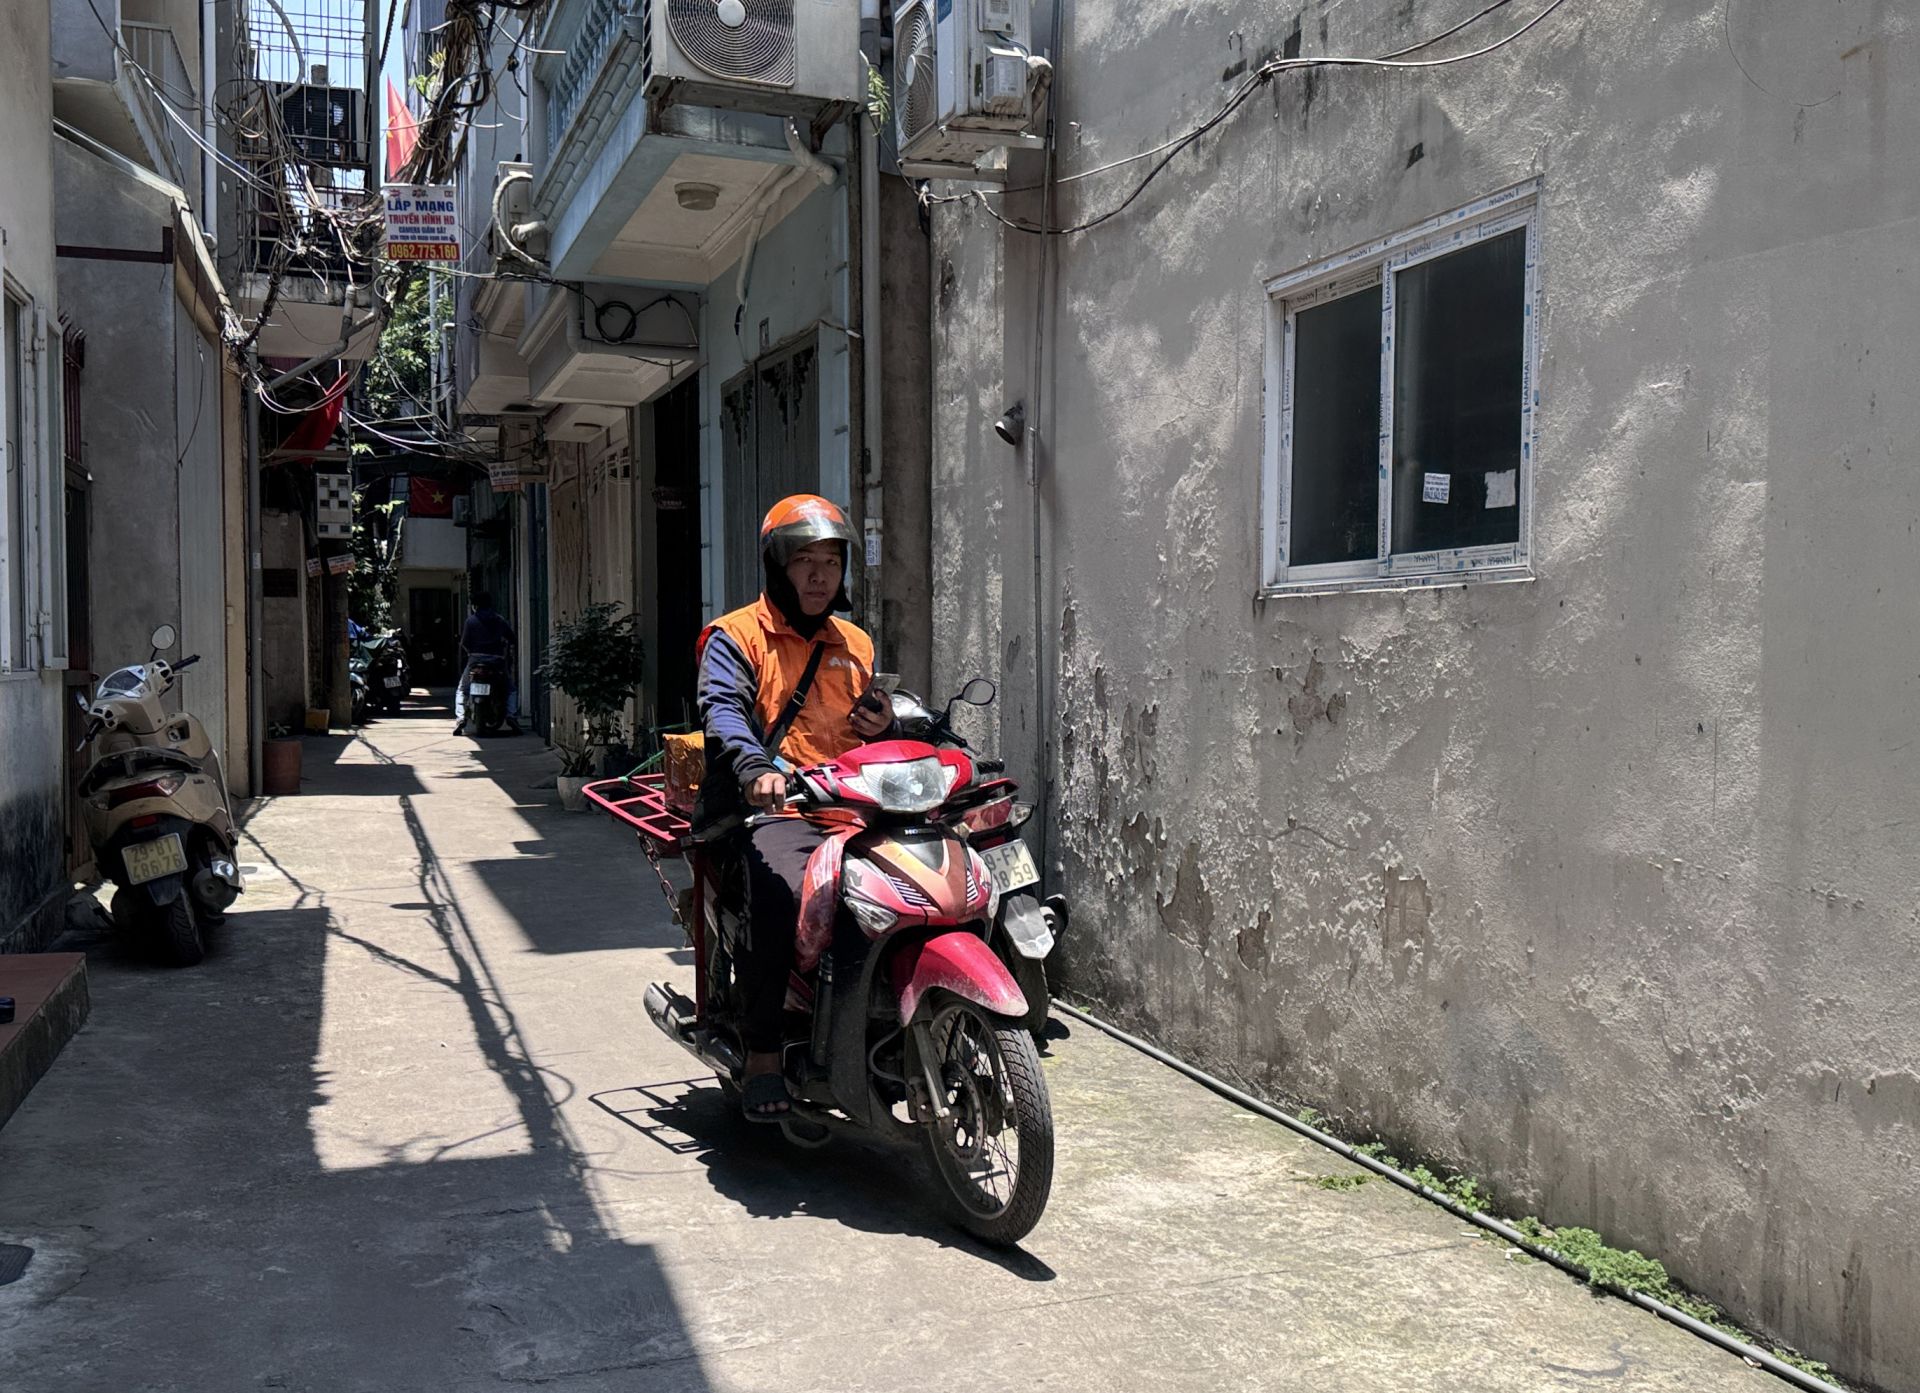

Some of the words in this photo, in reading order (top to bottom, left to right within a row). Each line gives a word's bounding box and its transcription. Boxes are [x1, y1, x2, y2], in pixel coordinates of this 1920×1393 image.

[415, 200, 454, 214] MẠNG
[422, 213, 441, 225] HÌNH
[443, 214, 455, 225] HD
[398, 226, 421, 234] CAMERA
[390, 243, 457, 260] 0962.775.160
[131, 838, 173, 863] 29-B1
[984, 845, 1021, 871] 9-F1
[133, 853, 183, 880] 486.76
